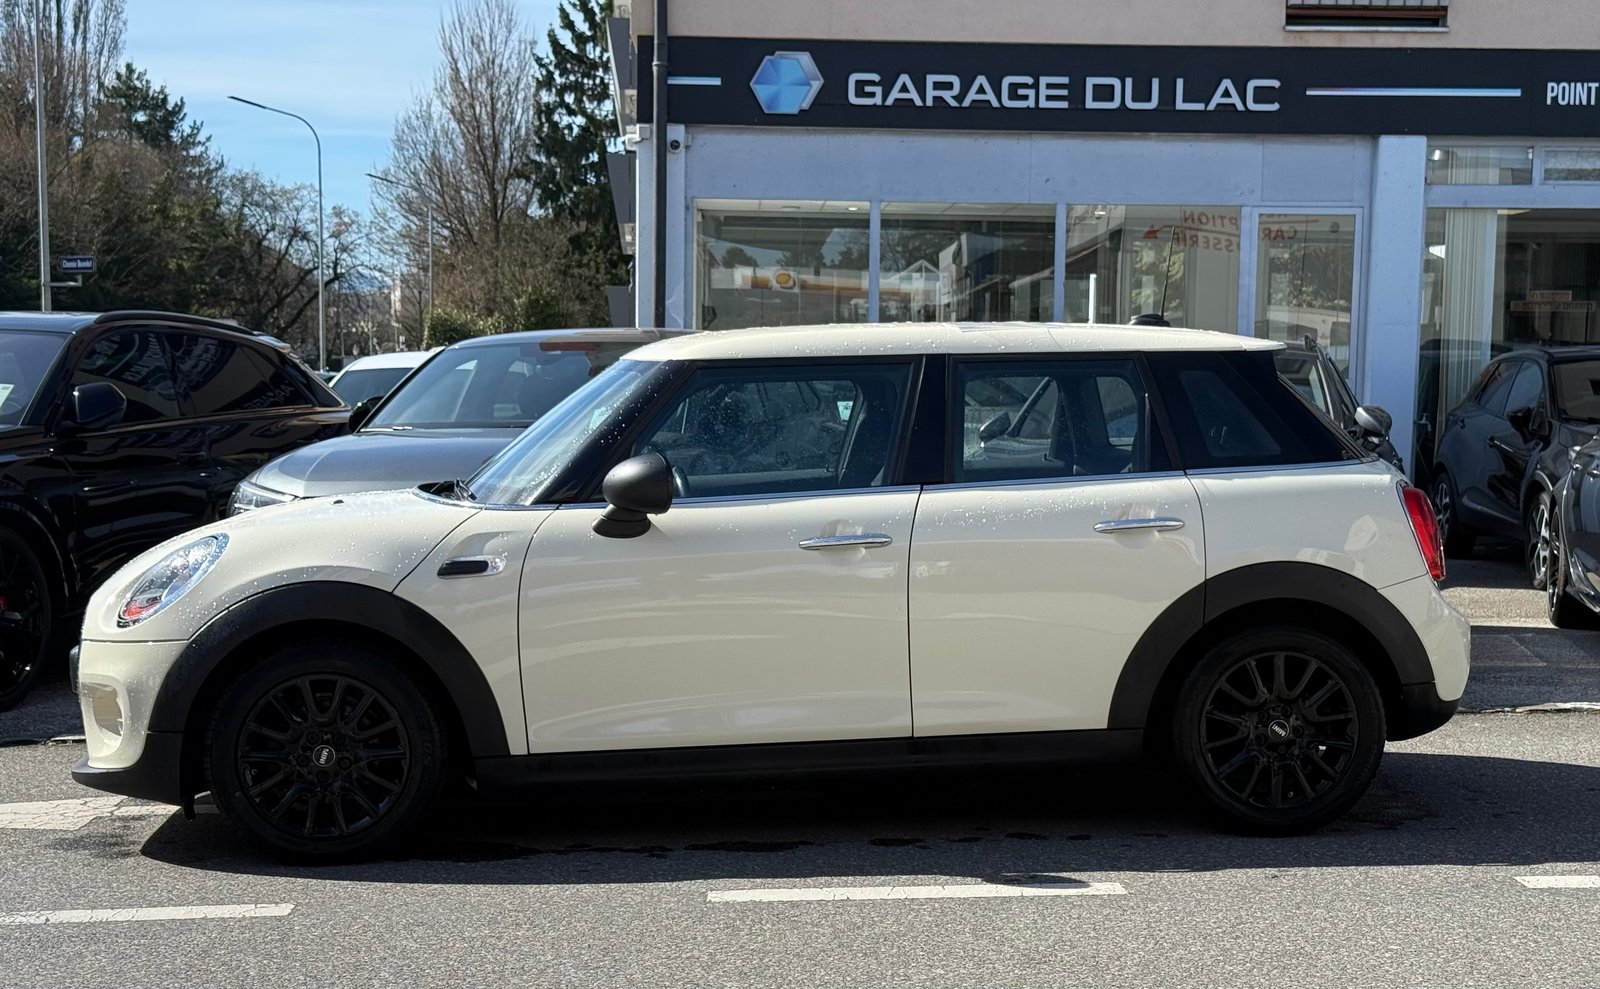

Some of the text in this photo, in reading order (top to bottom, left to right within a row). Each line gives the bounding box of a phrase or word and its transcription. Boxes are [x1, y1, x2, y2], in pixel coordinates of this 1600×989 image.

[848, 73, 1282, 112] GARAGE DU LAC
[1546, 82, 1599, 106] POINT
